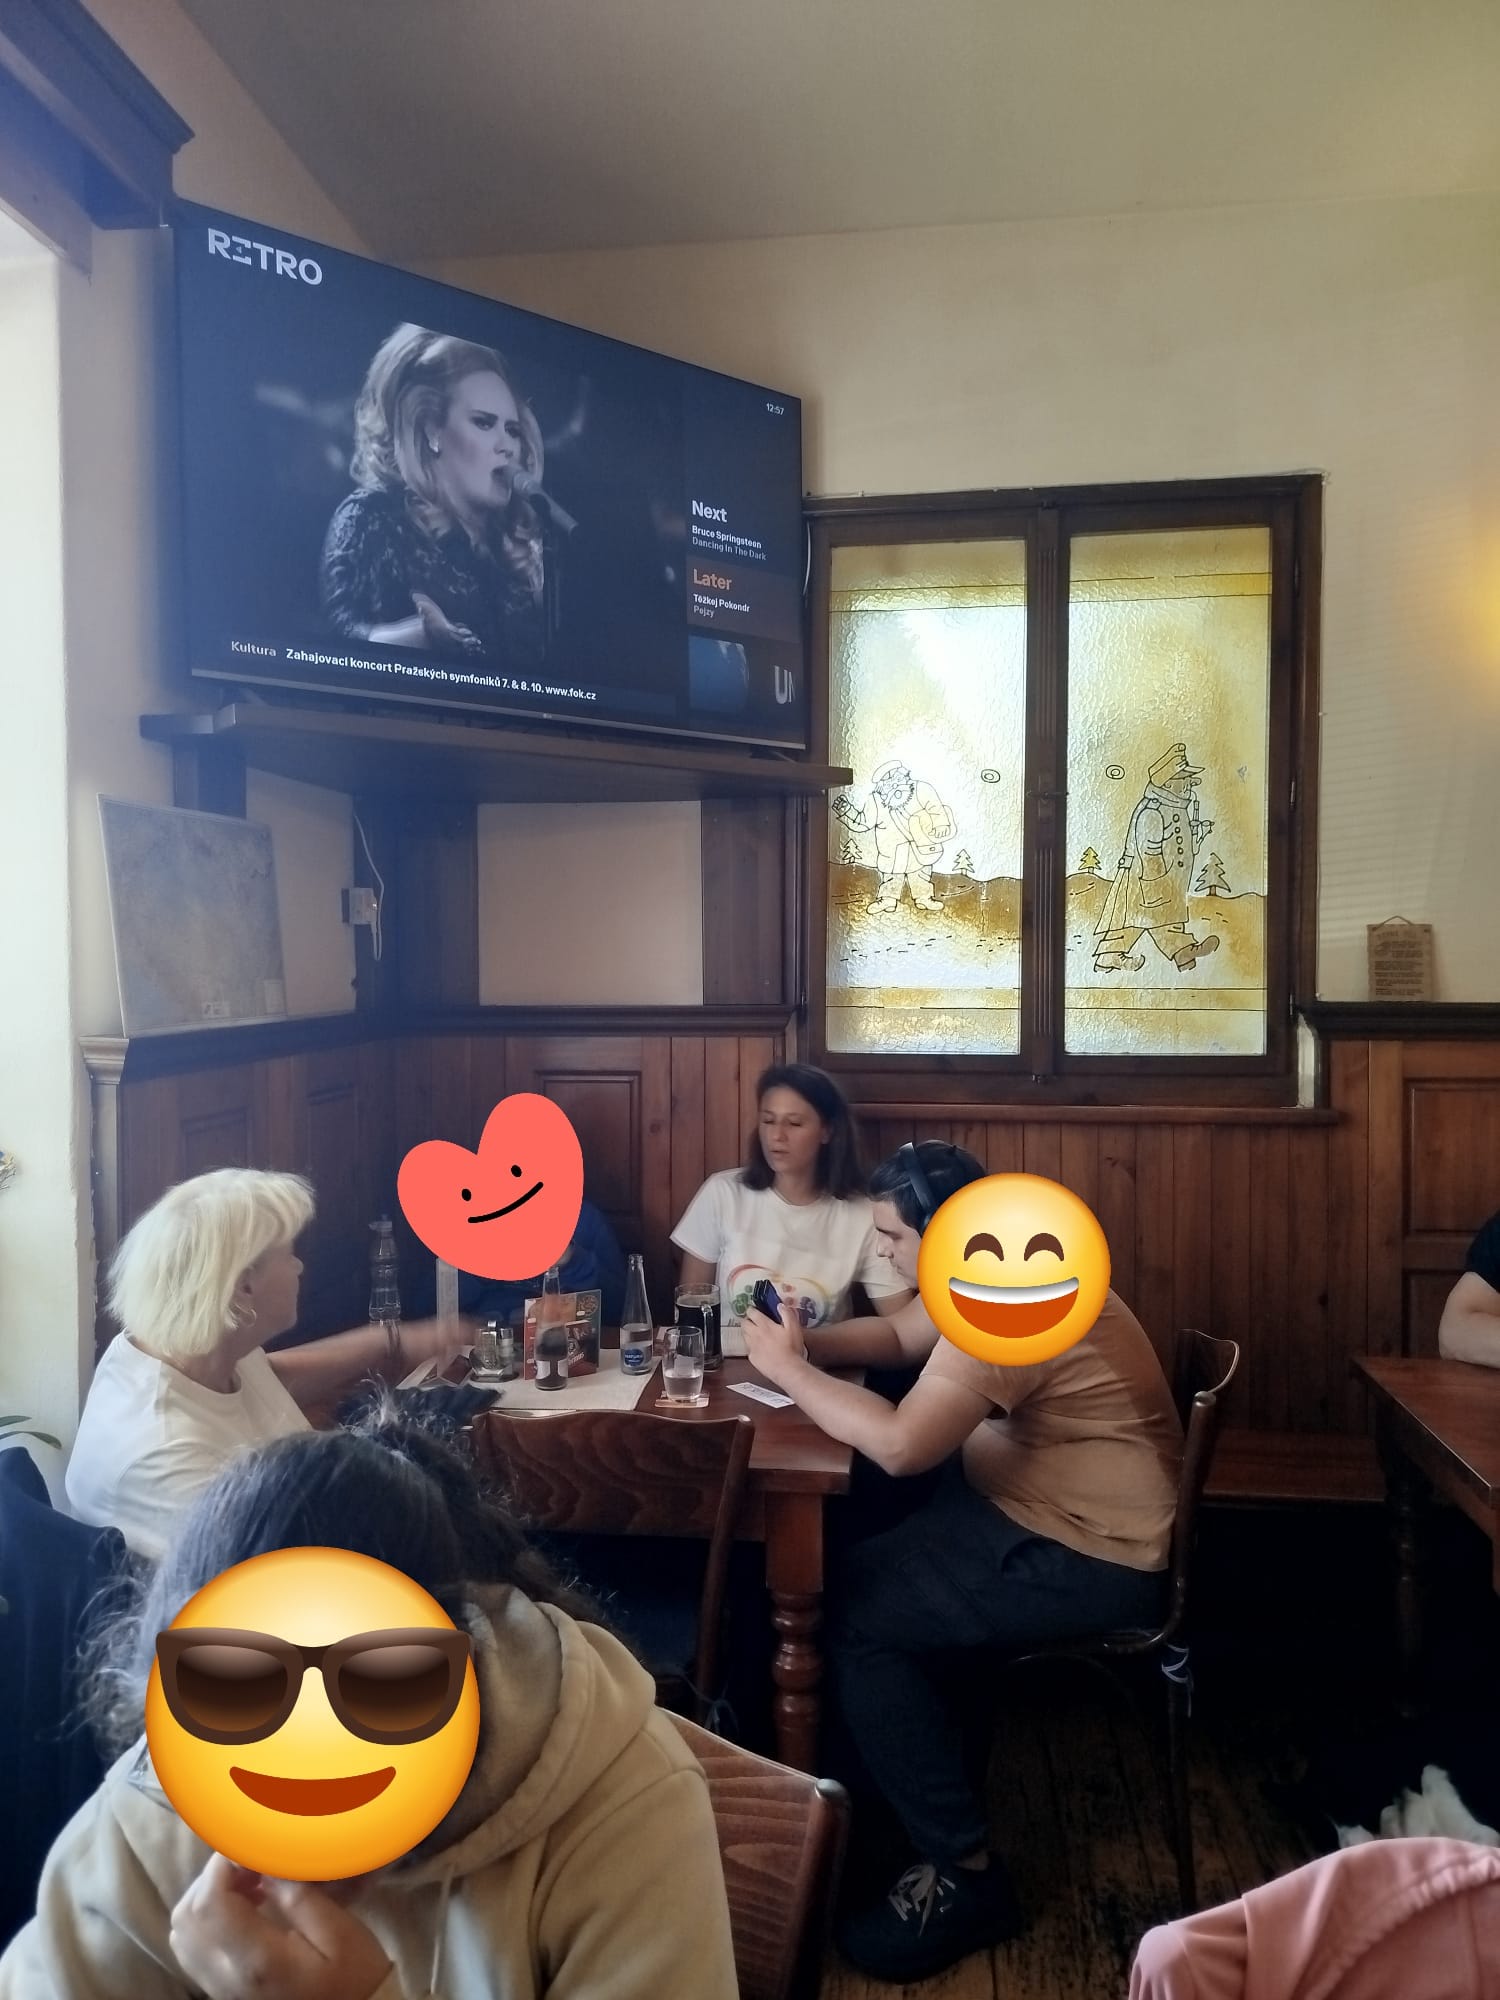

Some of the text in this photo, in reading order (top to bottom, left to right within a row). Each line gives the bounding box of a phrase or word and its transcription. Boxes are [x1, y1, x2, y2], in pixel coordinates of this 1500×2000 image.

[207, 227, 323, 286] RETRO
[766, 402, 785, 416] 12:57
[692, 500, 728, 523] Next
[692, 525, 762, 550] Bruce Springsteen
[692, 536, 767, 561] Dancing In The Dark
[693, 568, 732, 591] Later
[718, 599, 750, 613] Pokondr
[231, 641, 277, 658] Kultura
[350, 657, 392, 673] koncert
[394, 663, 448, 680] Pražských
[449, 672, 501, 688] symfoniků
[502, 679, 510, 689] 7.
[511, 679, 520, 690] &
[521, 681, 530, 692] 8.
[545, 686, 597, 701] www.fok.cz
